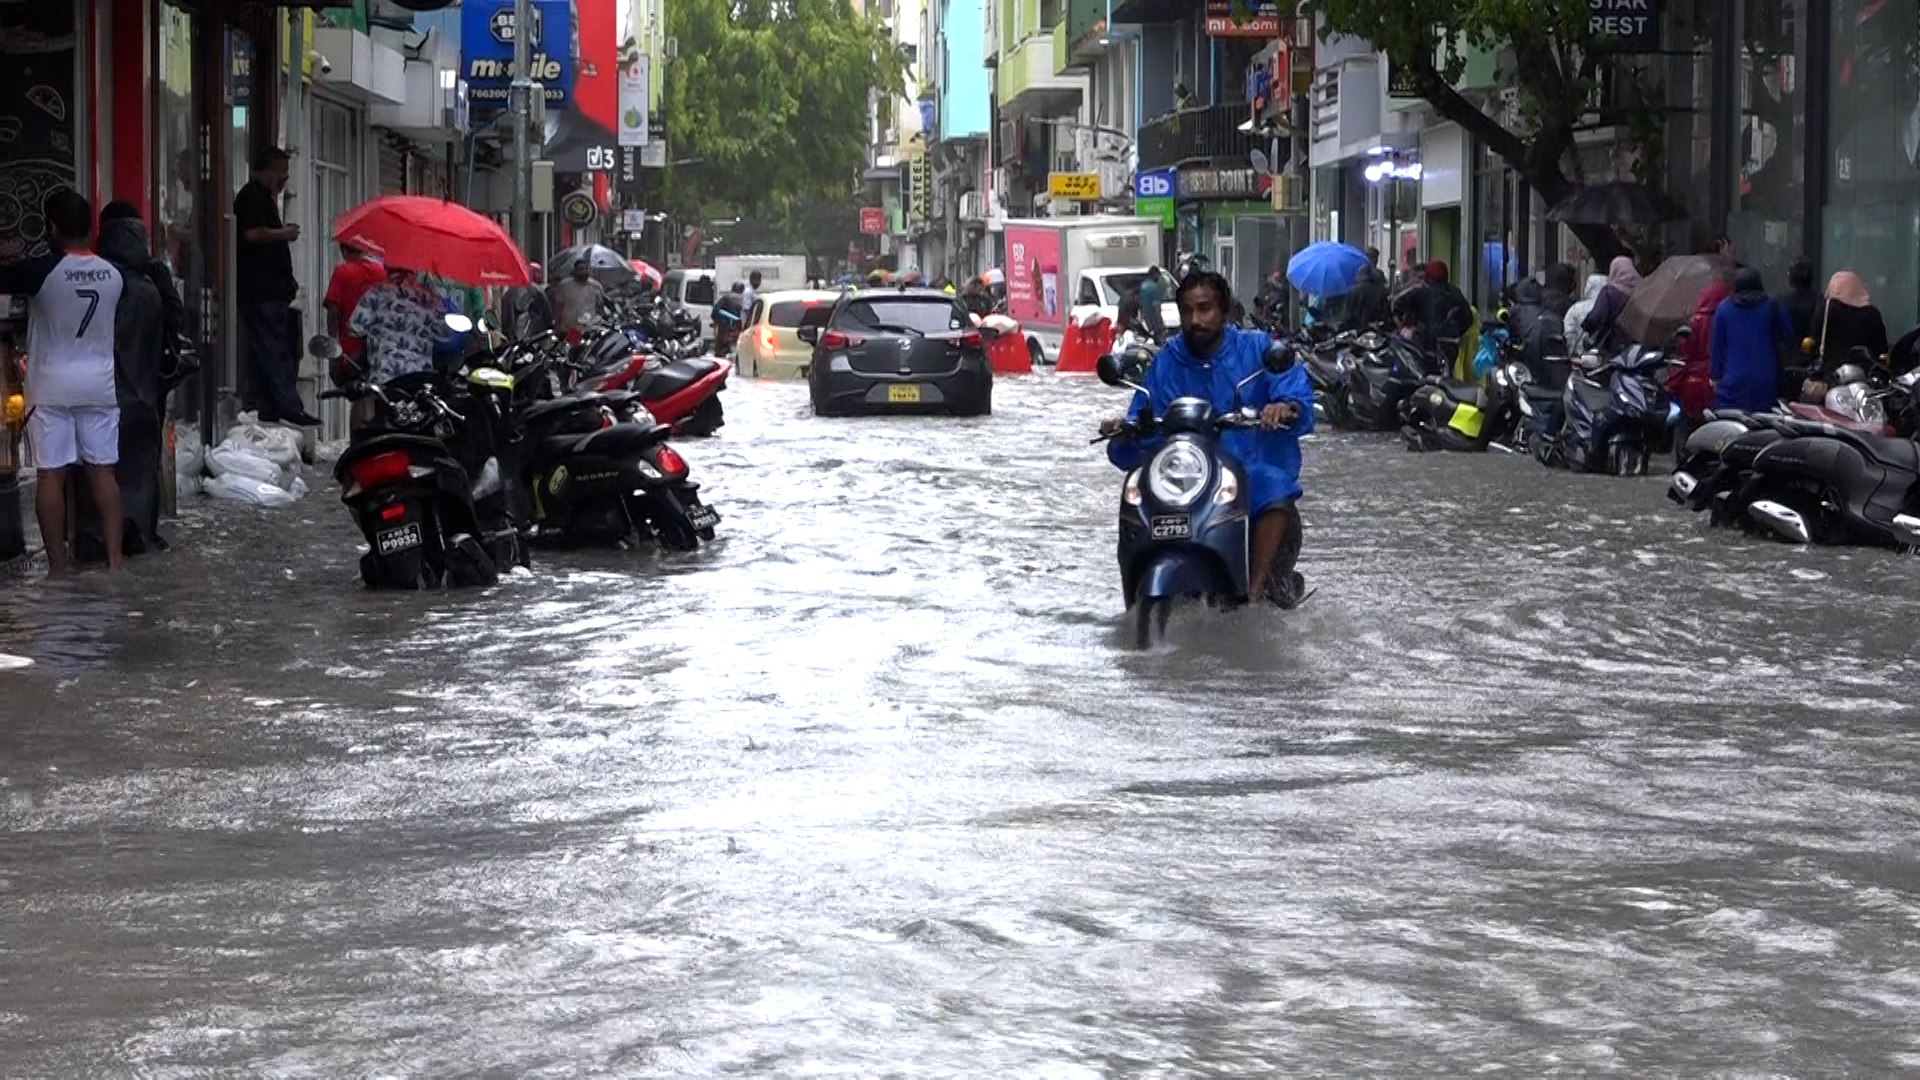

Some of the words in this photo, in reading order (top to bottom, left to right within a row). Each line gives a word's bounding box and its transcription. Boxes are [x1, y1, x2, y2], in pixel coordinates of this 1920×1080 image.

[1589, 0, 1648, 10] STAR
[1588, 16, 1649, 35] REST
[1218, 169, 1255, 192] POINT
[75, 289, 100, 338] 7
